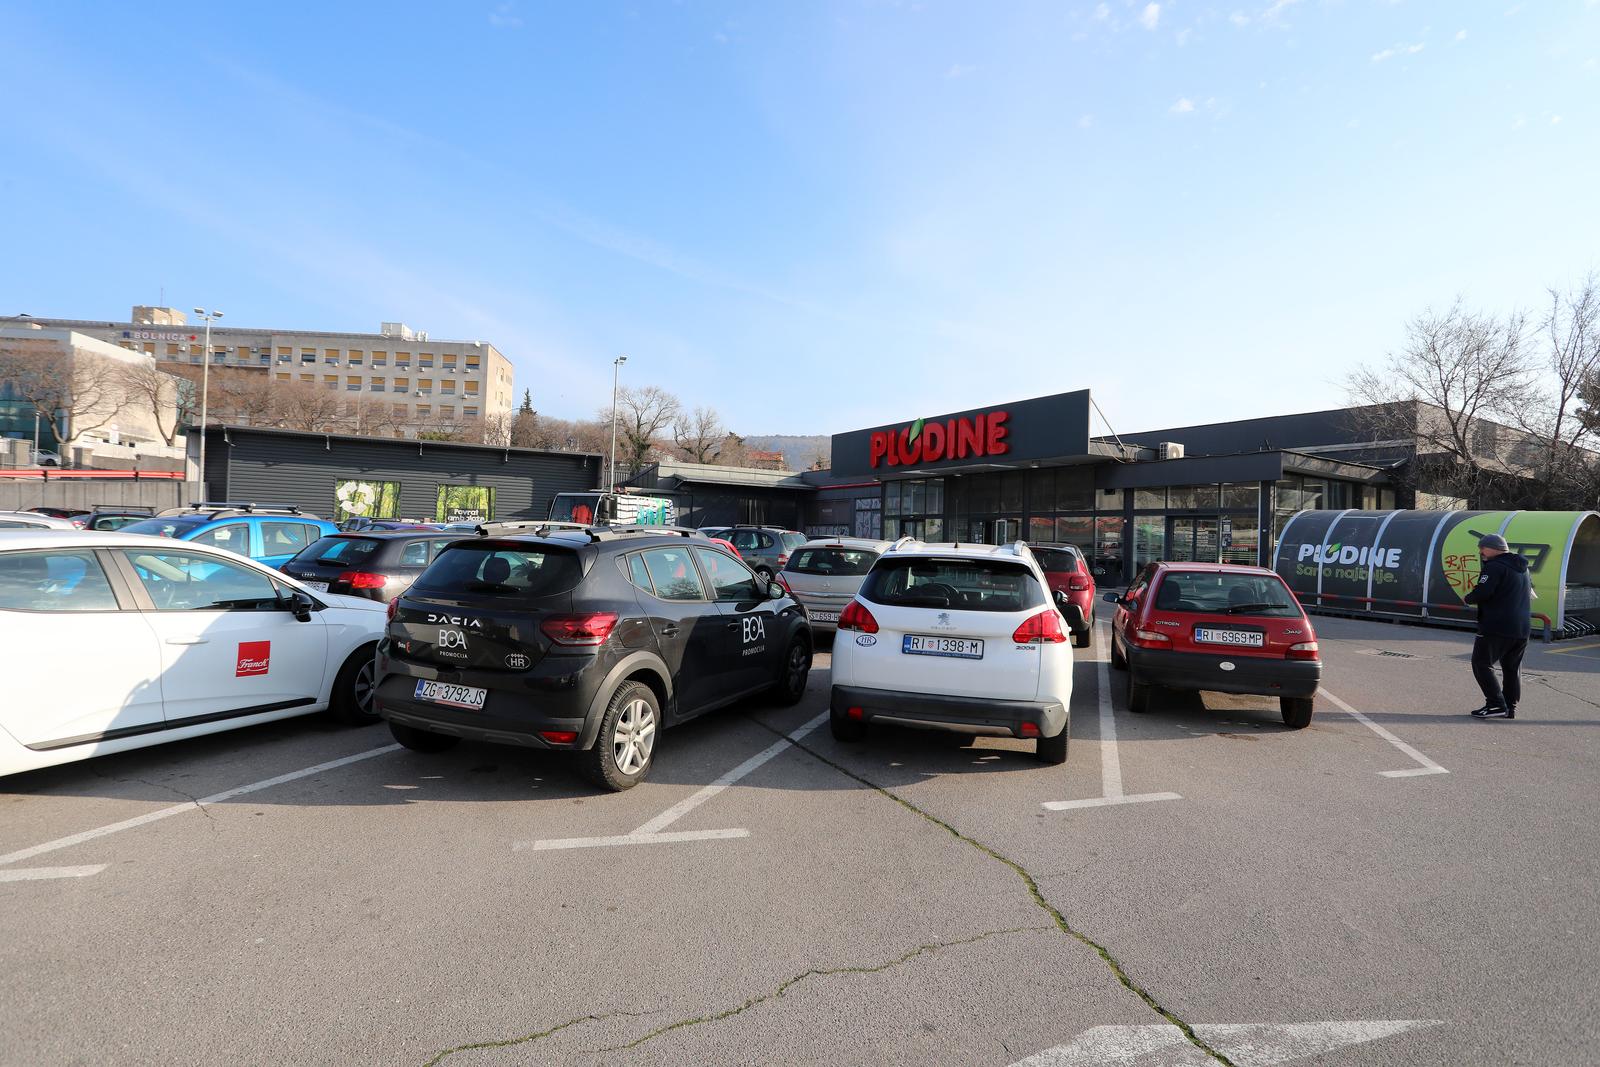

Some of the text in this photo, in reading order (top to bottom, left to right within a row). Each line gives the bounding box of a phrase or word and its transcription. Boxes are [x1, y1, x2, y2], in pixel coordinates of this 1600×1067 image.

[134, 331, 186, 341] BOLNICA
[870, 411, 1009, 468] PLODINE
[1298, 543, 1402, 568] PLODINE
[1296, 563, 1398, 585] Sao najblje.
[427, 613, 481, 628] DACIA
[742, 615, 765, 643] BOA
[438, 629, 468, 650] BOA
[911, 637, 925, 650] RI
[1202, 629, 1214, 641] RI
[510, 657, 525, 667] HR
[422, 681, 438, 698] ZG
